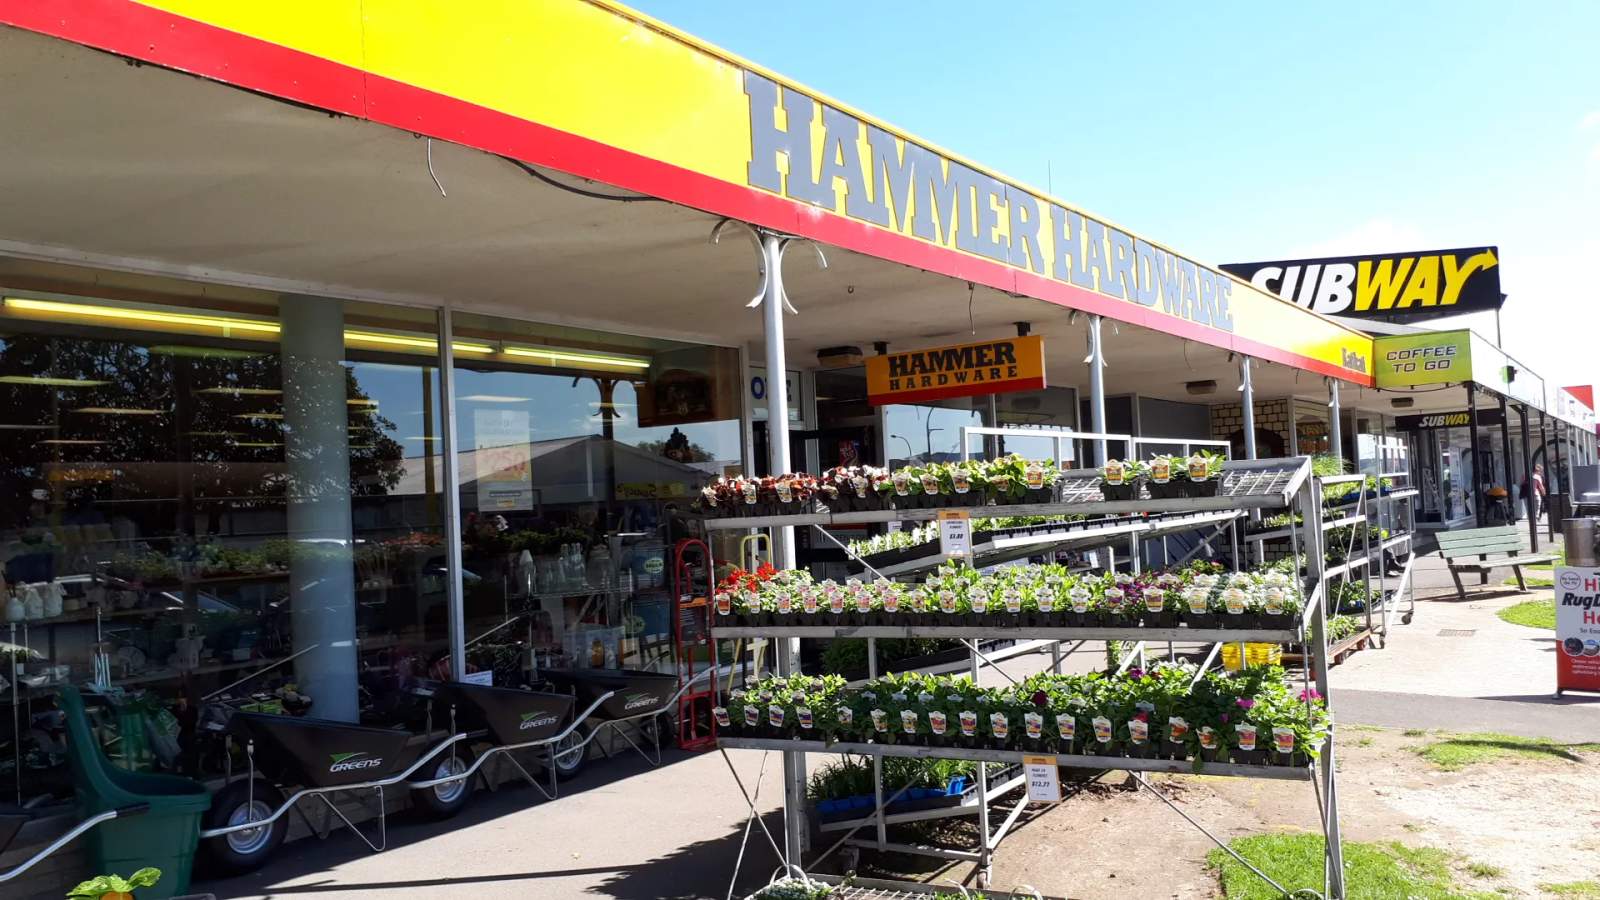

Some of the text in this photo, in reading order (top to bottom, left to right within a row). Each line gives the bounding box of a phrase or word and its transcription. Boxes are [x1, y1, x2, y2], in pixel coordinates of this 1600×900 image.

[743, 70, 1234, 332] HAMMER HARDWARE
[1250, 249, 1498, 314] SUBWAY
[888, 342, 1017, 378] HAMMER
[1386, 345, 1457, 361] COFFEE
[1392, 359, 1451, 373] TO GO
[889, 365, 1018, 391] HARDWARE
[1419, 413, 1470, 428] SUBWAY
[624, 697, 660, 711] GREENS
[520, 715, 559, 730] GREENS
[329, 757, 382, 773] GREENS
